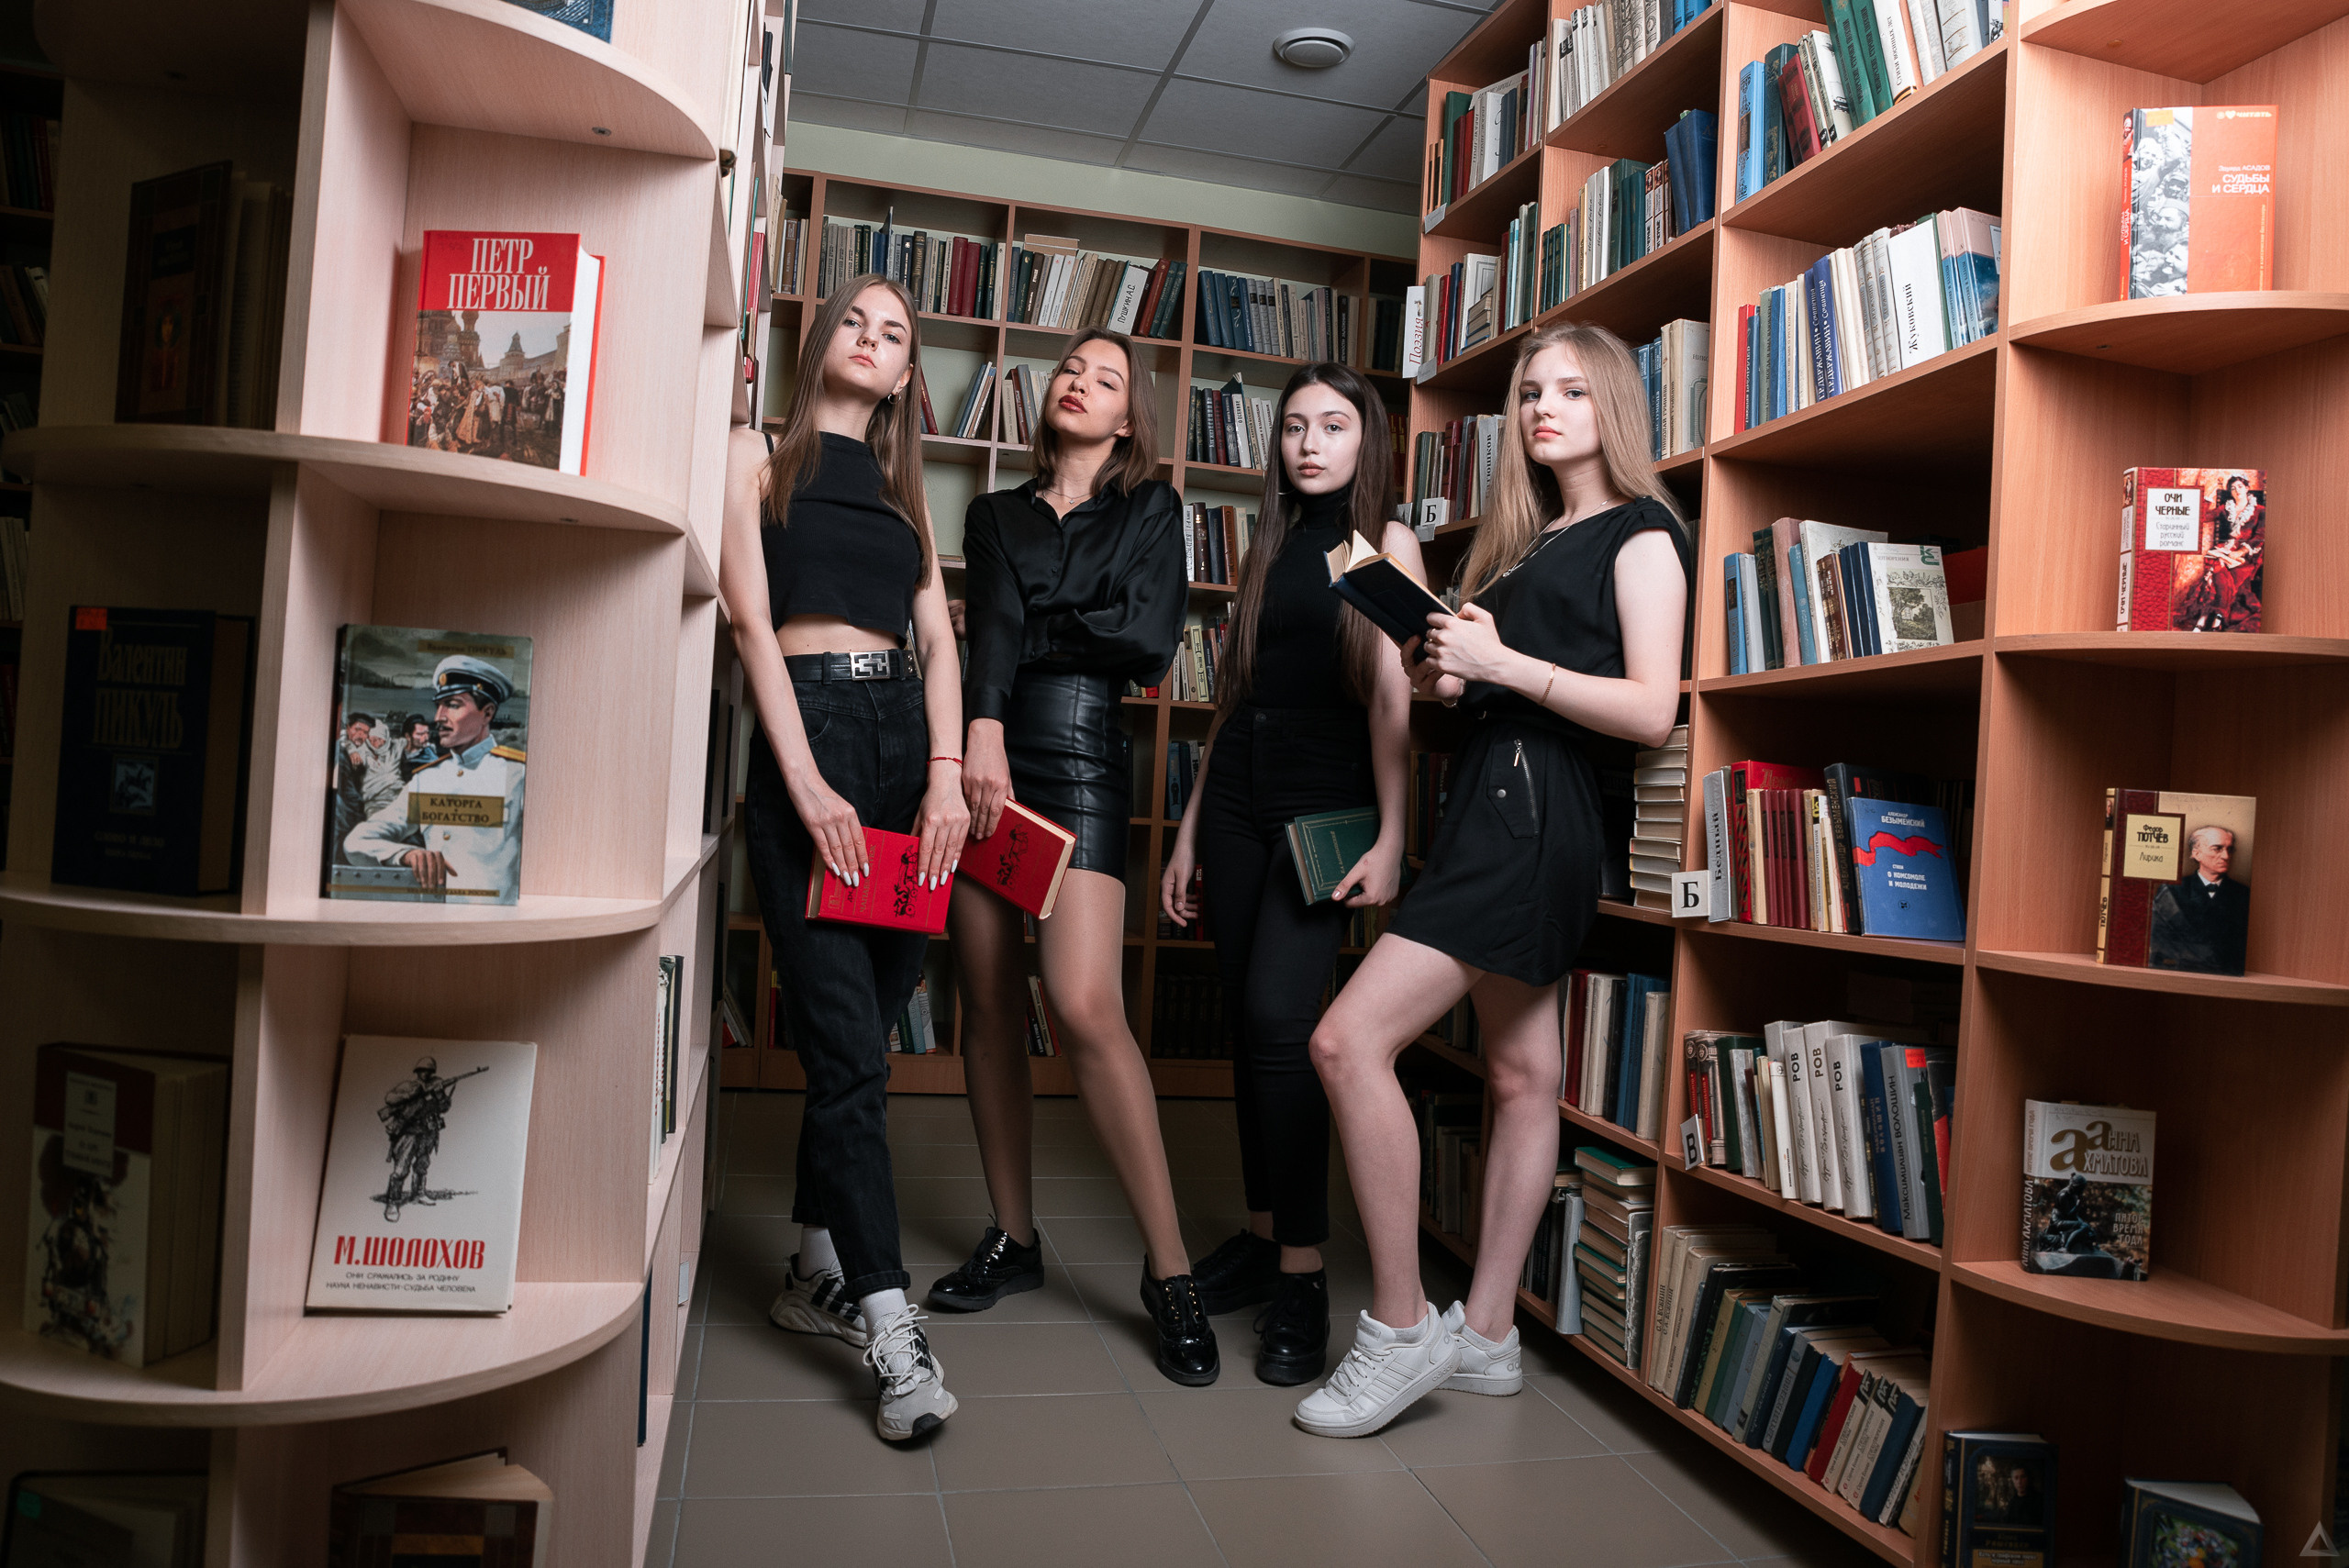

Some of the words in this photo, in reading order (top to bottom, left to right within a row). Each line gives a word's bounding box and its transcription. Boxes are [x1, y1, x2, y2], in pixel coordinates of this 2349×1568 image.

[2212, 185, 2221, 194] И
[2223, 183, 2270, 195] СЕРДЦА
[2222, 173, 2270, 184] СУДЬБЫ
[470, 238, 534, 274] ПЕТР
[446, 266, 551, 311] ПЕРВЫЙ
[1117, 295, 1132, 324] ПУШКИН
[1904, 283, 1919, 355] Жуковский
[1408, 318, 1422, 365] Поэзия
[2155, 506, 2190, 516] ЧЕРНЫЕ
[2165, 493, 2182, 503] ОЧИ
[1424, 505, 1437, 523] Б
[97, 625, 188, 686] Валентин
[95, 687, 184, 749] ПИКУЛЬ
[422, 811, 489, 824] БОГАТСТВО
[429, 797, 483, 809] КАТОРГА
[1828, 778, 1845, 840] БЕЗЫМЕНСКИЙ
[1881, 816, 1925, 828] БЕЗЫМЕНСКИЙ
[1712, 812, 1721, 881] Бедный
[2137, 832, 2169, 844] ТЮТЧЕВ
[2140, 852, 2164, 862] Лирика
[1894, 872, 1926, 882] КОМСОМОЛЕ
[1895, 881, 1927, 891] МОЛОДЕЖИ
[859, 877, 872, 913] ЧАПАЕВ
[1681, 881, 1700, 909] Б
[1792, 1052, 1801, 1082] РОВ
[1813, 1047, 1823, 1078] РОВ
[1833, 1061, 1843, 1091] РОВ
[1887, 1074, 1902, 1138] ВОЛОШИН
[1686, 1132, 1698, 1165] В
[1895, 1140, 1910, 1220] Максимилиан
[2023, 1180, 2034, 1239] АХМАТОВА
[2115, 1213, 2143, 1223] ПЯТОЕ
[2113, 1223, 2143, 1235] ВРЕМЯ
[2120, 1234, 2143, 1246] ГОДА
[367, 1273, 413, 1281] СРАЖАЛИСЬ
[429, 1274, 460, 1283] РОДИНУ
[437, 1284, 476, 1293] ЧЕЛОВЕКА
[1656, 1284, 1667, 1317] ЕСЕНИН
[1664, 1287, 1674, 1319] ЕСЕНИН
